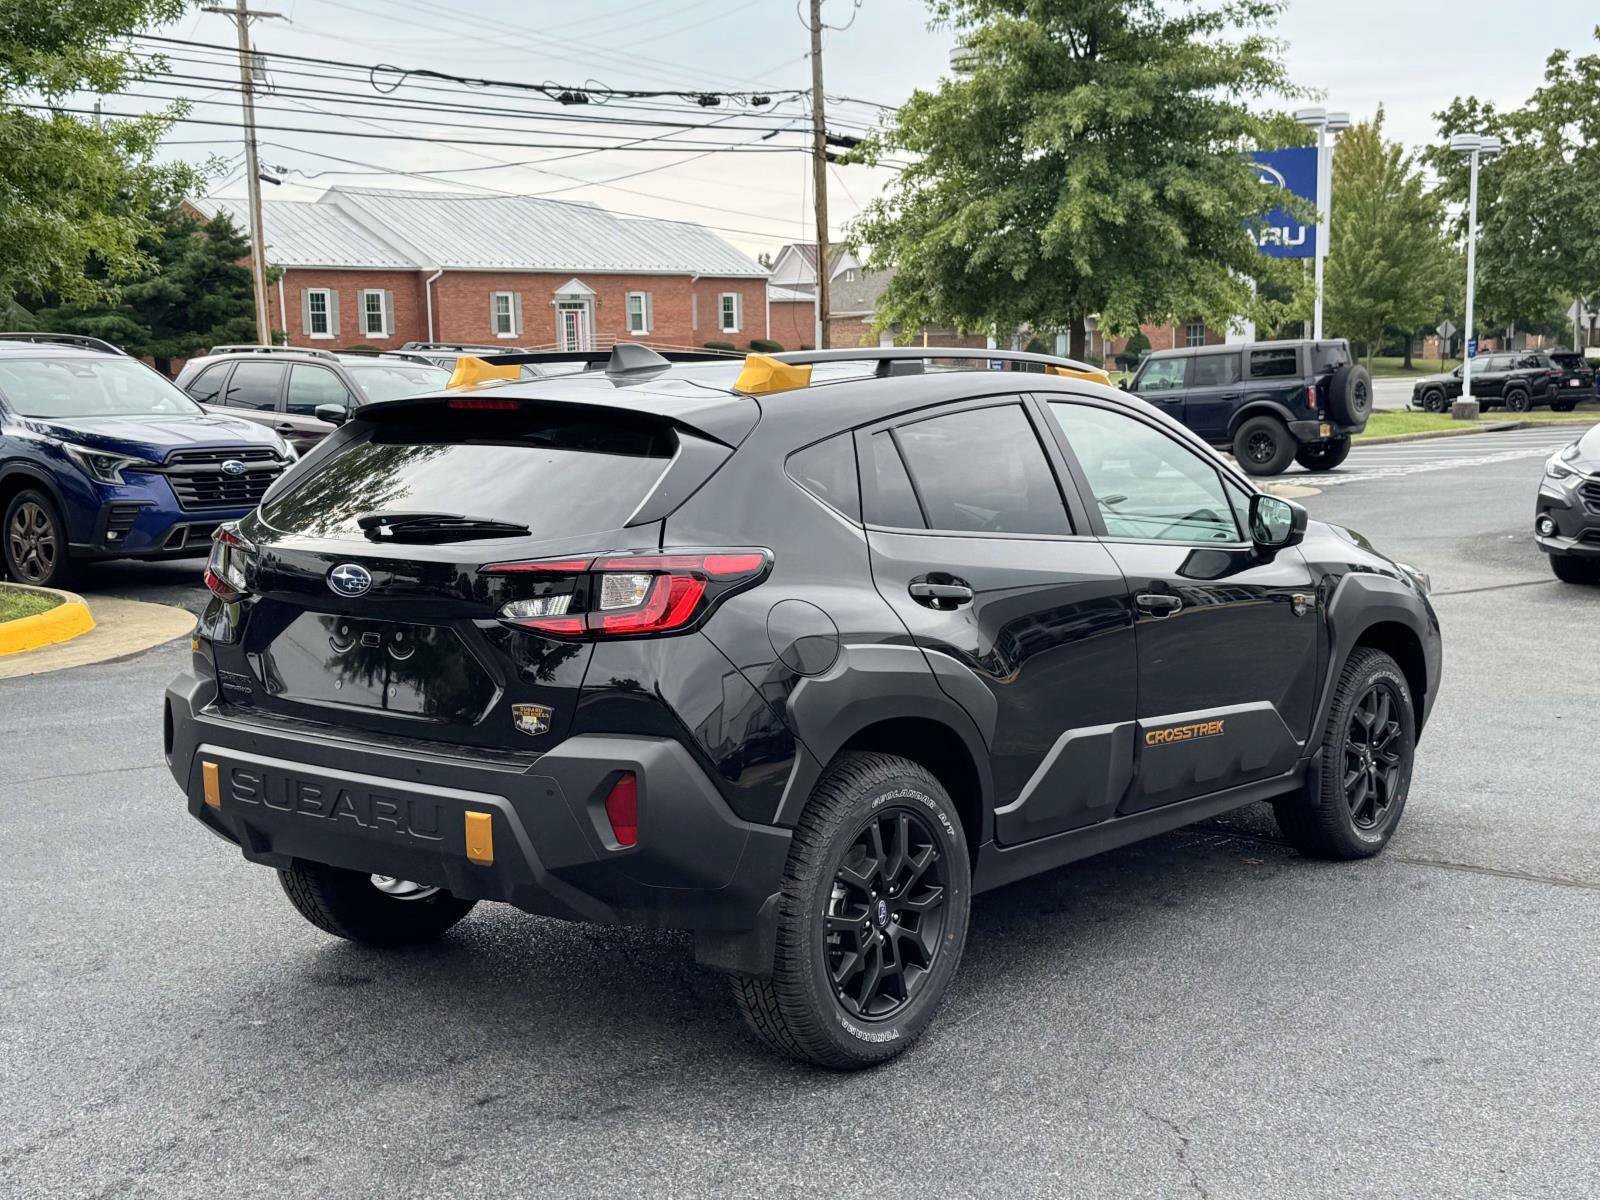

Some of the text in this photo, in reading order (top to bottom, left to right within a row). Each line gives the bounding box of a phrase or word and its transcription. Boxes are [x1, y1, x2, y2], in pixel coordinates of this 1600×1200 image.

[1145, 720, 1225, 745] CROSSTREK
[231, 767, 444, 840] SUBARU
[872, 789, 936, 809] GEOLANDAR
[841, 1018, 900, 1043] YOKOHAMA
